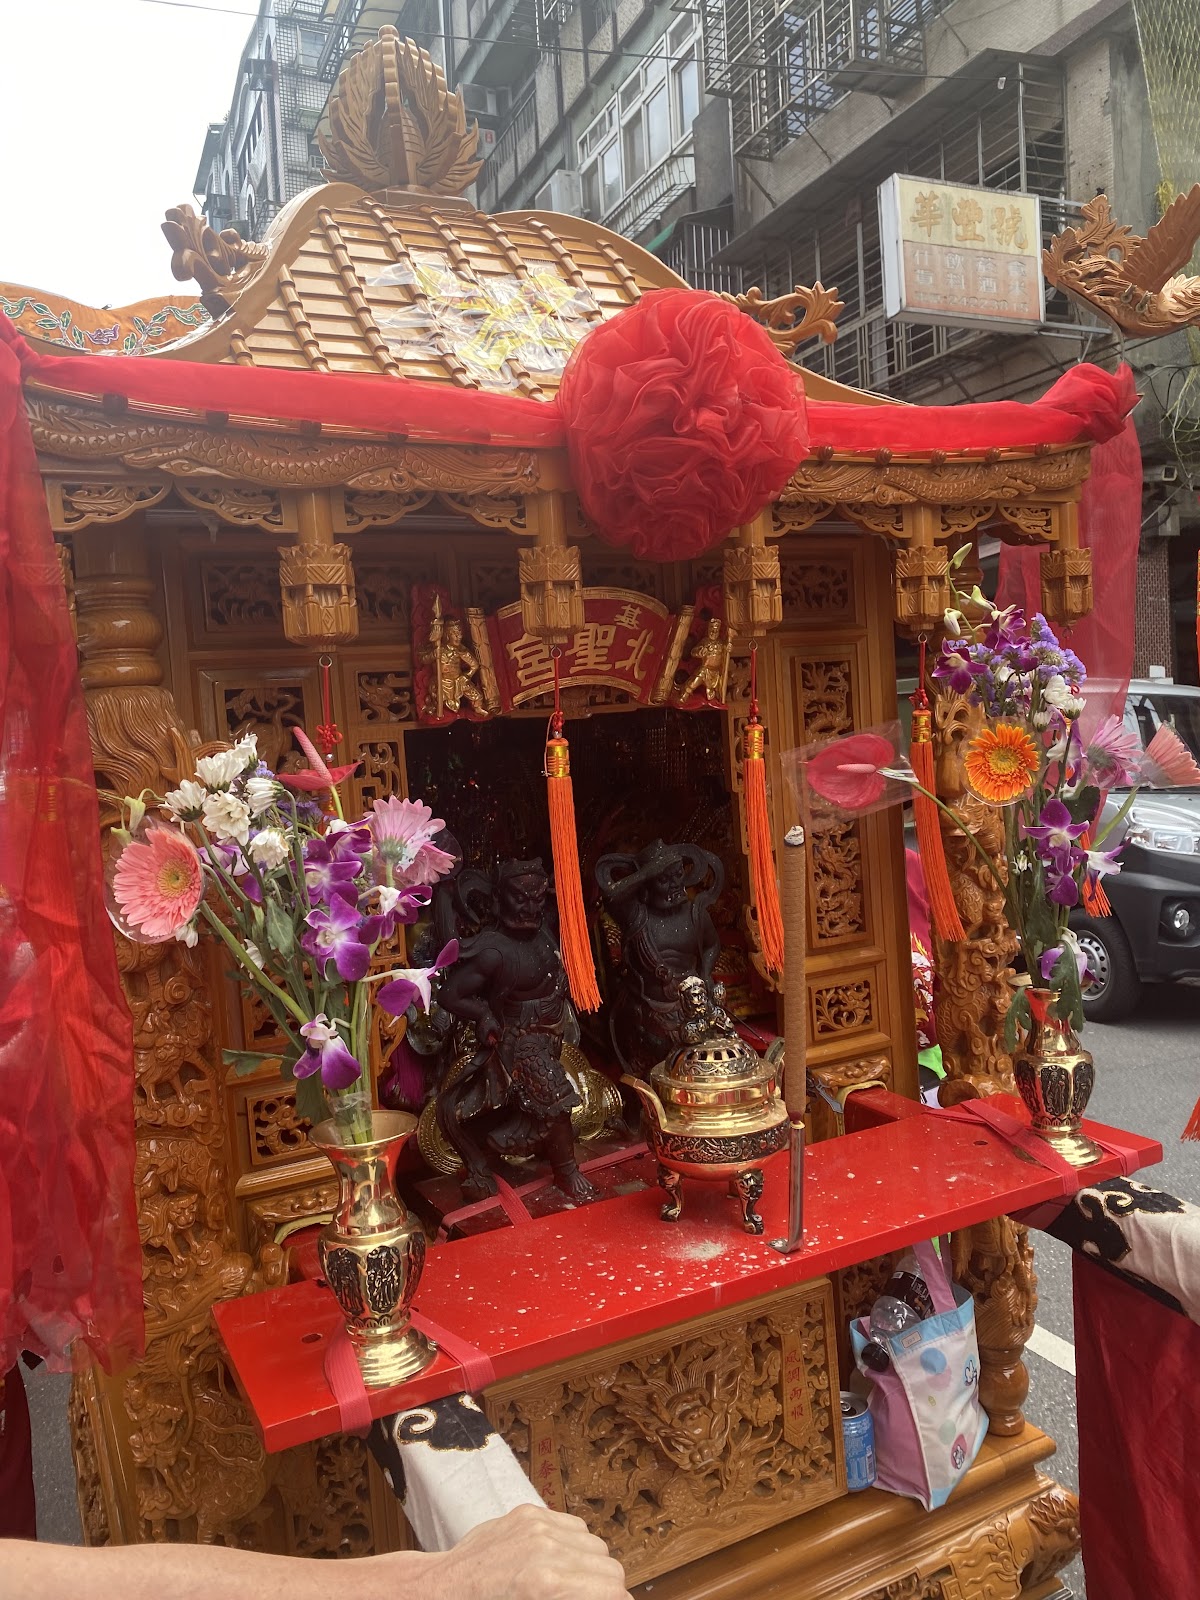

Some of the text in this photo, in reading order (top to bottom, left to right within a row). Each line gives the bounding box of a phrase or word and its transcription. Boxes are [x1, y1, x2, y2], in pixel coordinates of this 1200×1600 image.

[910, 190, 1029, 250] 華豐號
[944, 252, 966, 291] 飲料
[614, 604, 642, 630] 基
[505, 622, 655, 687] 北聖宮
[785, 1351, 805, 1421] 風調雨順
